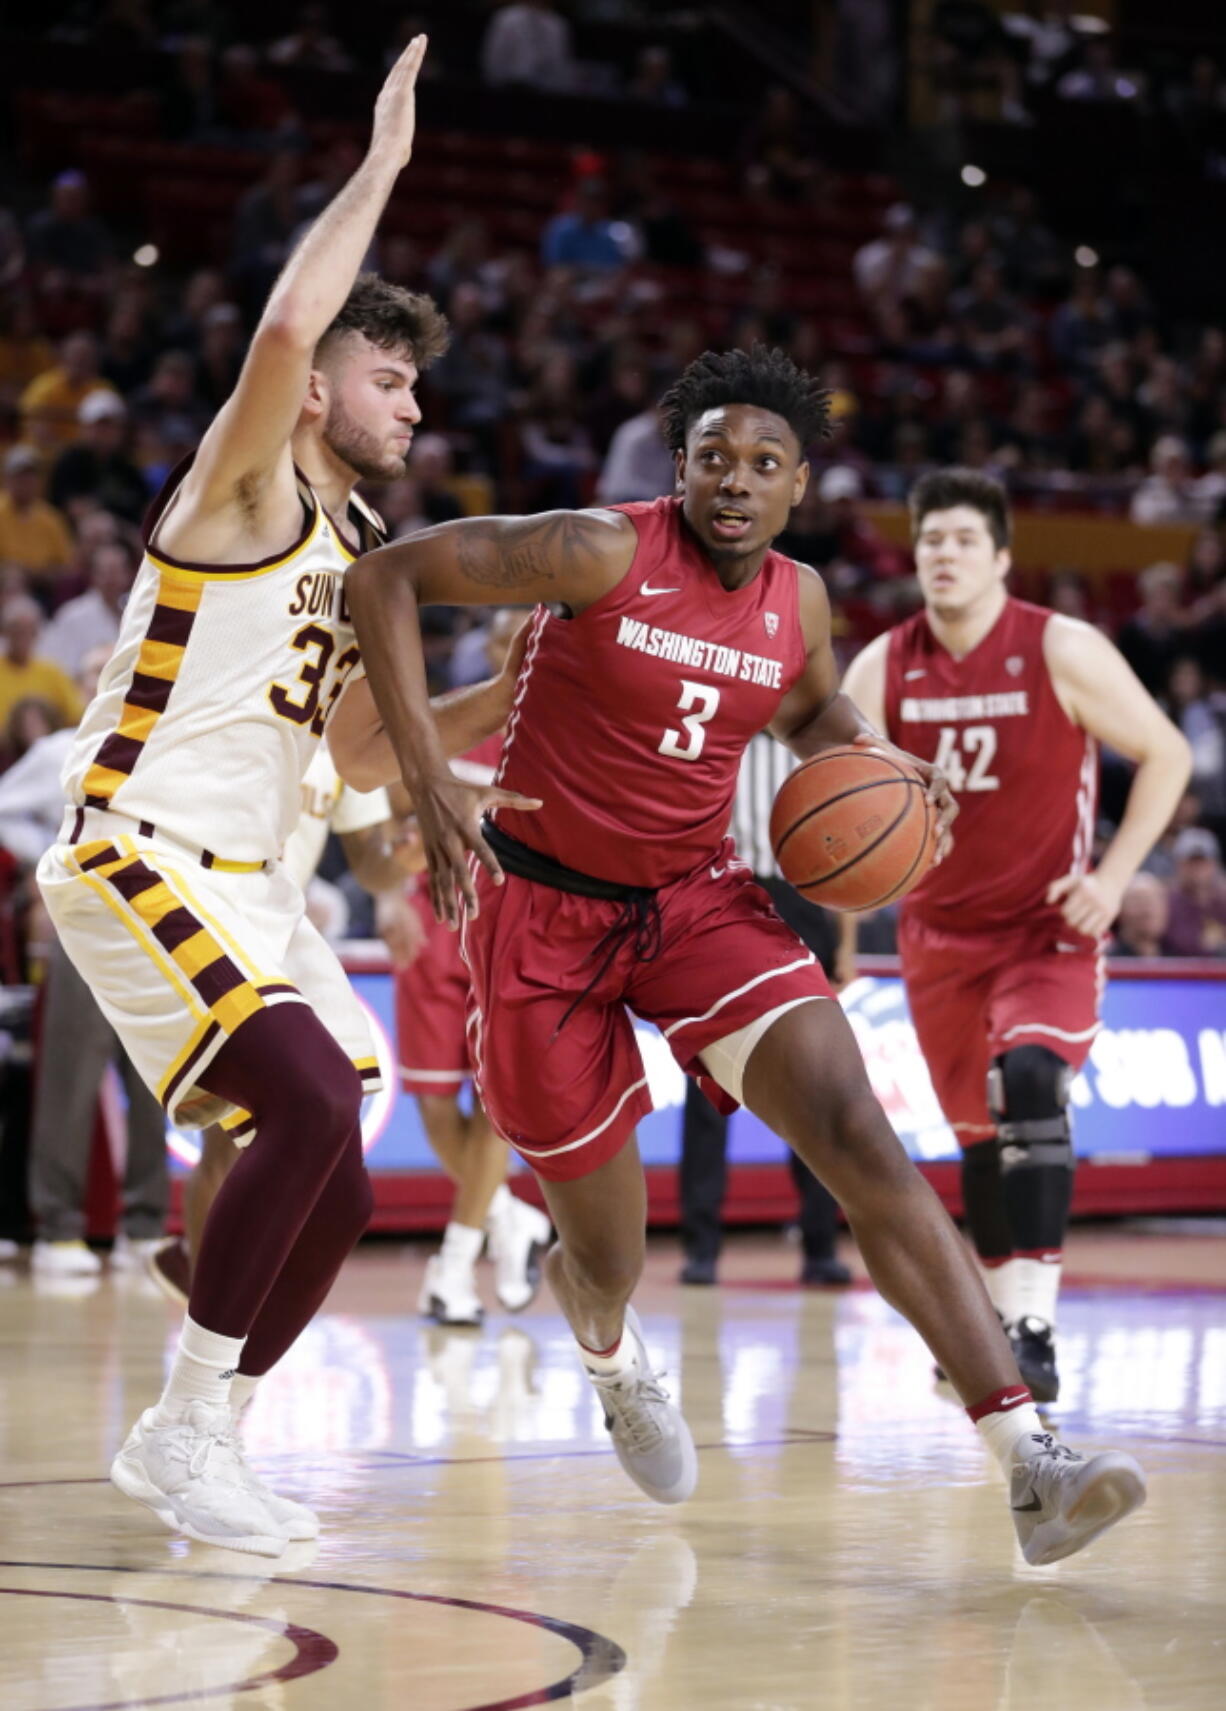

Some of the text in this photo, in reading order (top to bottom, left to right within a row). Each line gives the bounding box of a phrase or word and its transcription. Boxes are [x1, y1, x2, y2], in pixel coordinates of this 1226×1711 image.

[289, 573, 336, 617] SUN
[616, 615, 742, 678] WASHINGTON
[739, 651, 784, 690] STATE
[657, 679, 721, 762] 3
[931, 725, 1000, 792] 42
